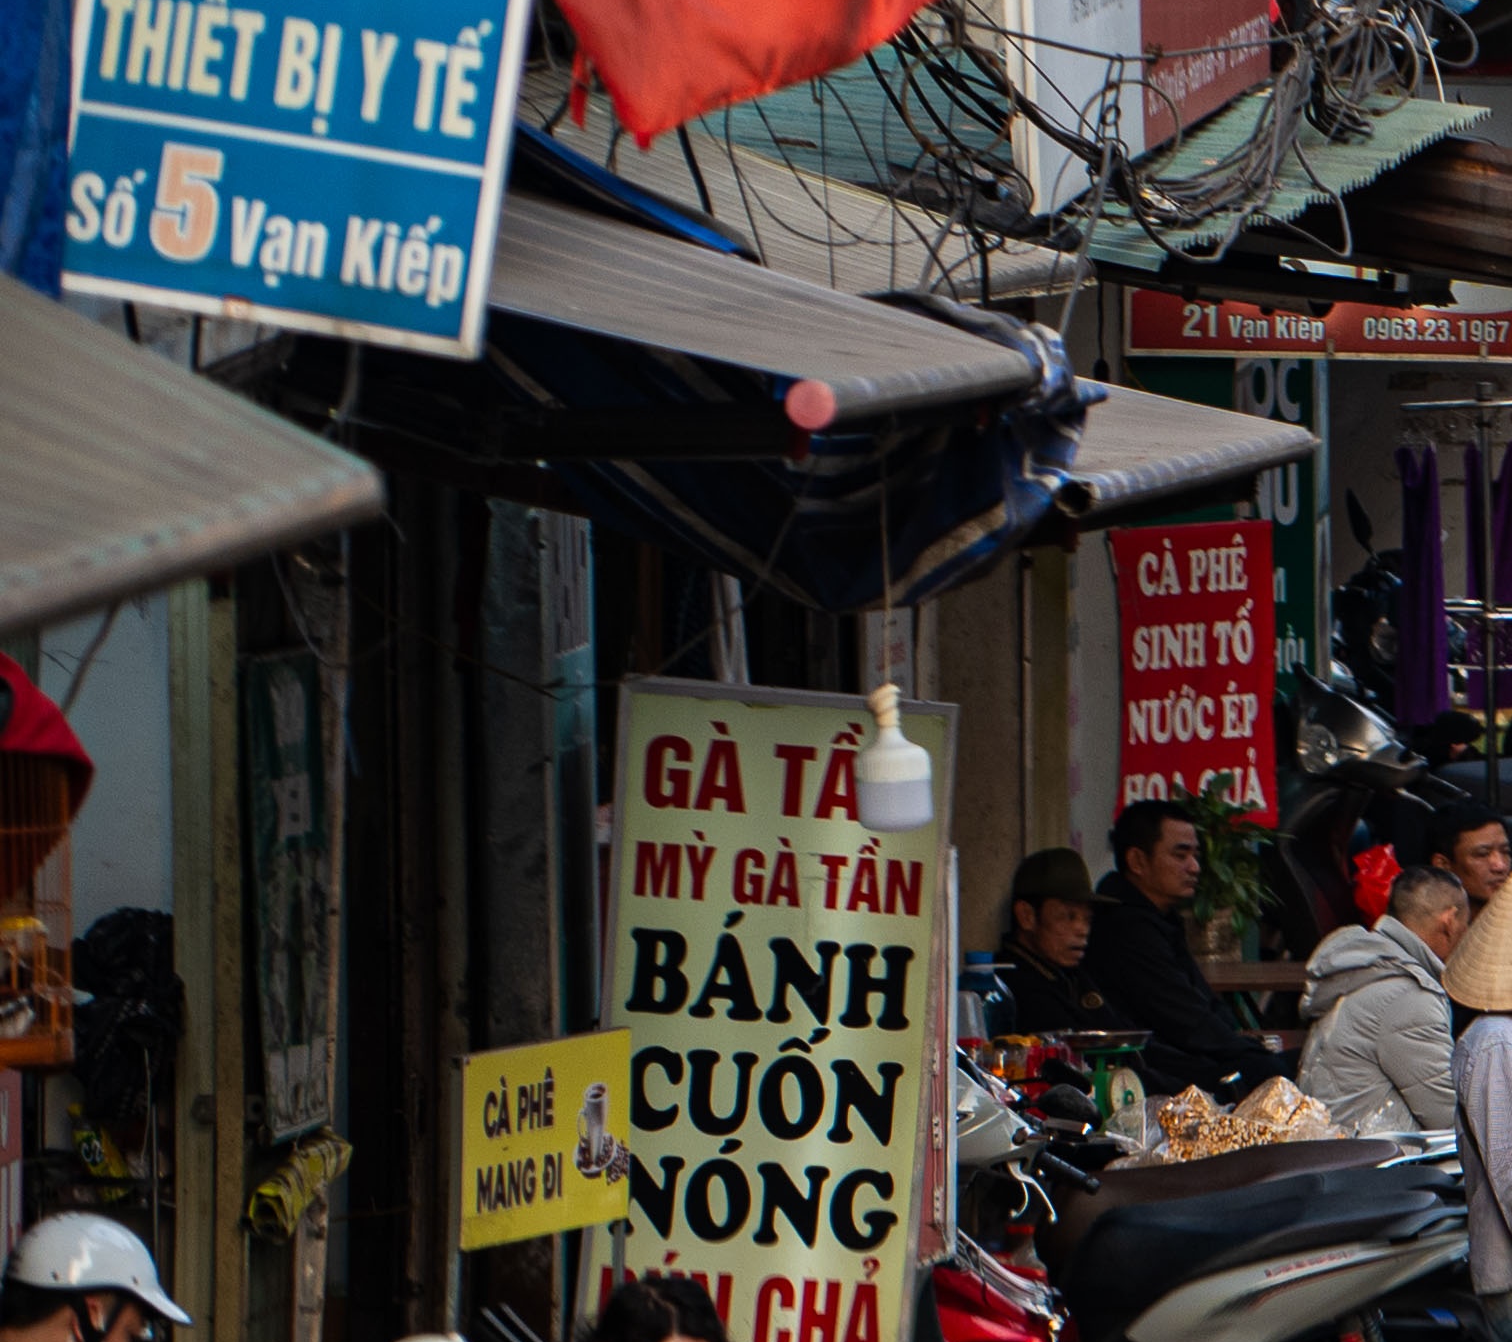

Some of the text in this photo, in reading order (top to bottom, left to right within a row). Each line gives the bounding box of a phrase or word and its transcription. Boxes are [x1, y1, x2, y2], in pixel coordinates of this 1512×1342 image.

[273, 15, 343, 135] BỊ
[361, 28, 398, 126] Y
[413, 20, 494, 140] TẾ
[65, 140, 465, 308] Số 5 Vạn Kiếp
[1182, 304, 1218, 338] 21
[1228, 314, 1269, 344] Vạn
[1363, 316, 1510, 344] 0963.23.1967
[1137, 532, 1248, 597] CÀ PHÊ
[1131, 598, 1255, 673] SINH TỐ
[1127, 682, 1260, 746] NƯỚC ÉP
[643, 722, 862, 822] GÀ TẦ
[634, 830, 924, 918] MỲ GÀ TẦN
[625, 910, 916, 1032] BÁNH
[482, 1057, 556, 1141] CÀ PHÊ
[630, 1029, 906, 1147] CUỐN
[475, 1147, 564, 1216] MANG ĐI
[609, 1139, 900, 1254] NÓNG
